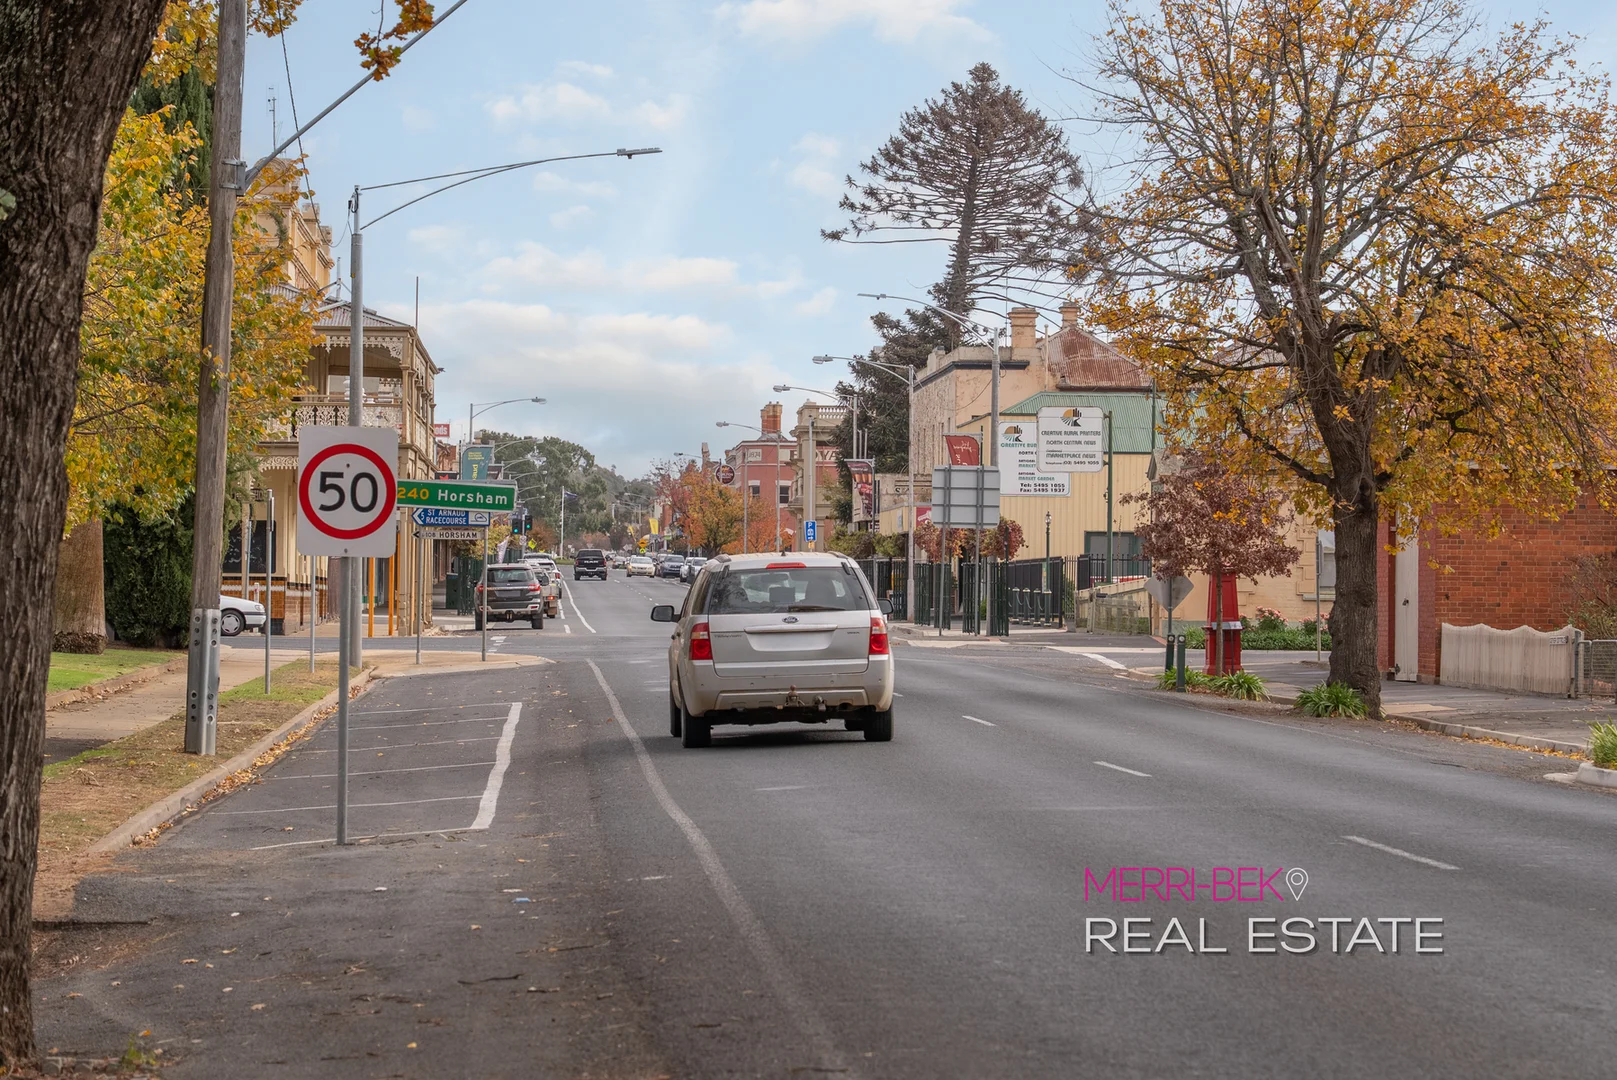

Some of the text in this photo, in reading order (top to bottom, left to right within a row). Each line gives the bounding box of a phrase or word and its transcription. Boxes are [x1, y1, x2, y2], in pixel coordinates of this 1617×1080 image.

[318, 470, 378, 513] 50
[438, 488, 508, 505] Horsham
[421, 511, 425, 521] 5
[427, 509, 466, 517] ST ARNAUD
[425, 516, 467, 525] RACECOURSE
[439, 531, 478, 539] HORSHAM
